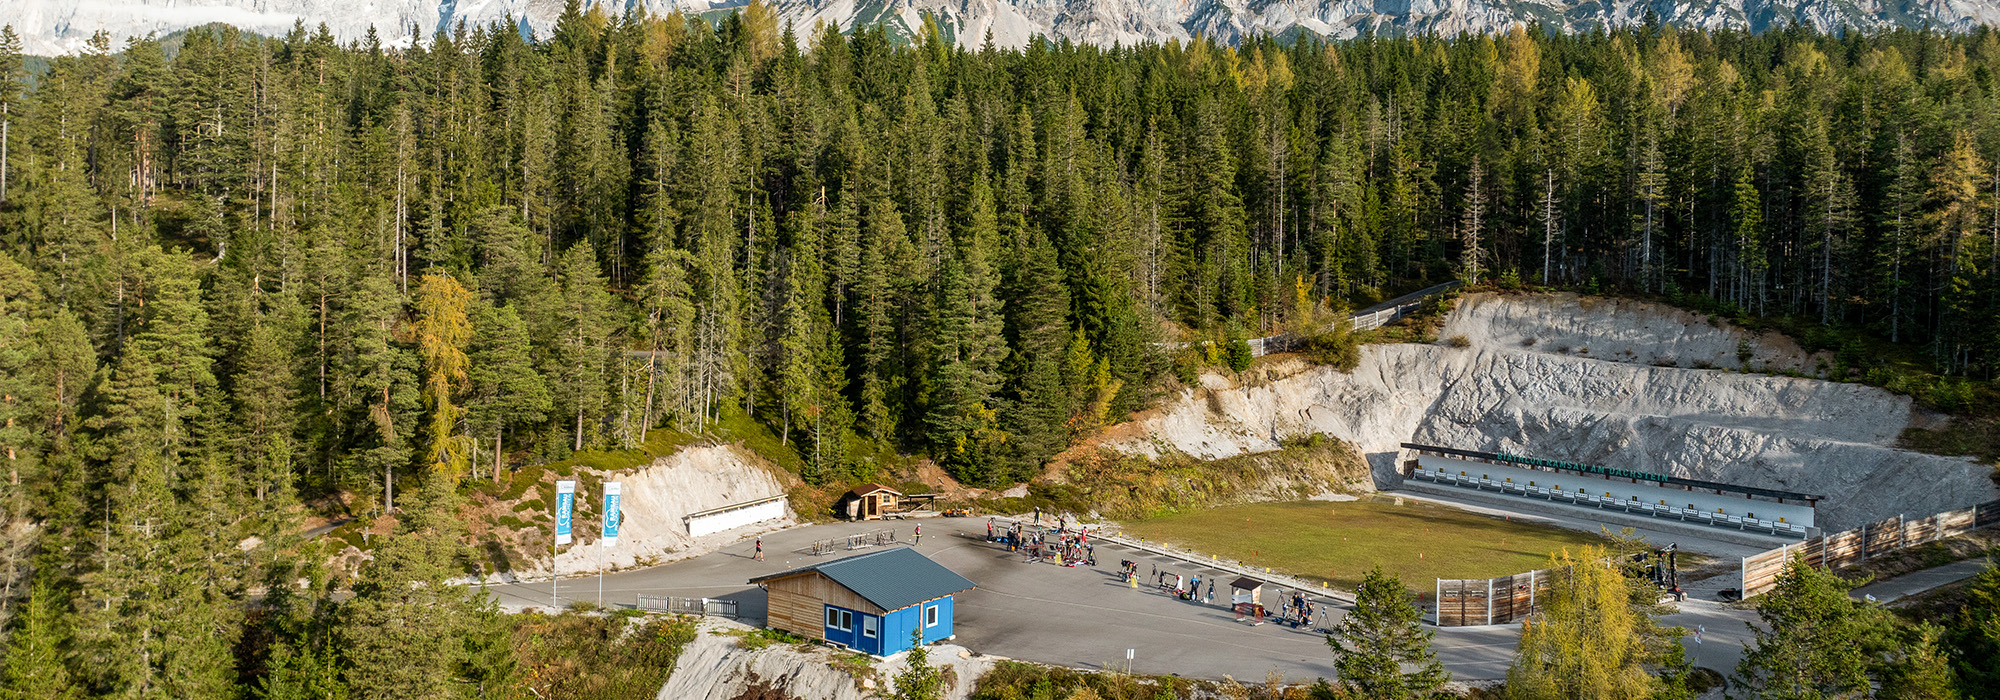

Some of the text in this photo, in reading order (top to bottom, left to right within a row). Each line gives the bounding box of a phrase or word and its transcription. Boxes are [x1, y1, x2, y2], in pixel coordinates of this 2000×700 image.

[1497, 452, 1669, 482] BIATHLON RAMSAU AM DACHSTEIN
